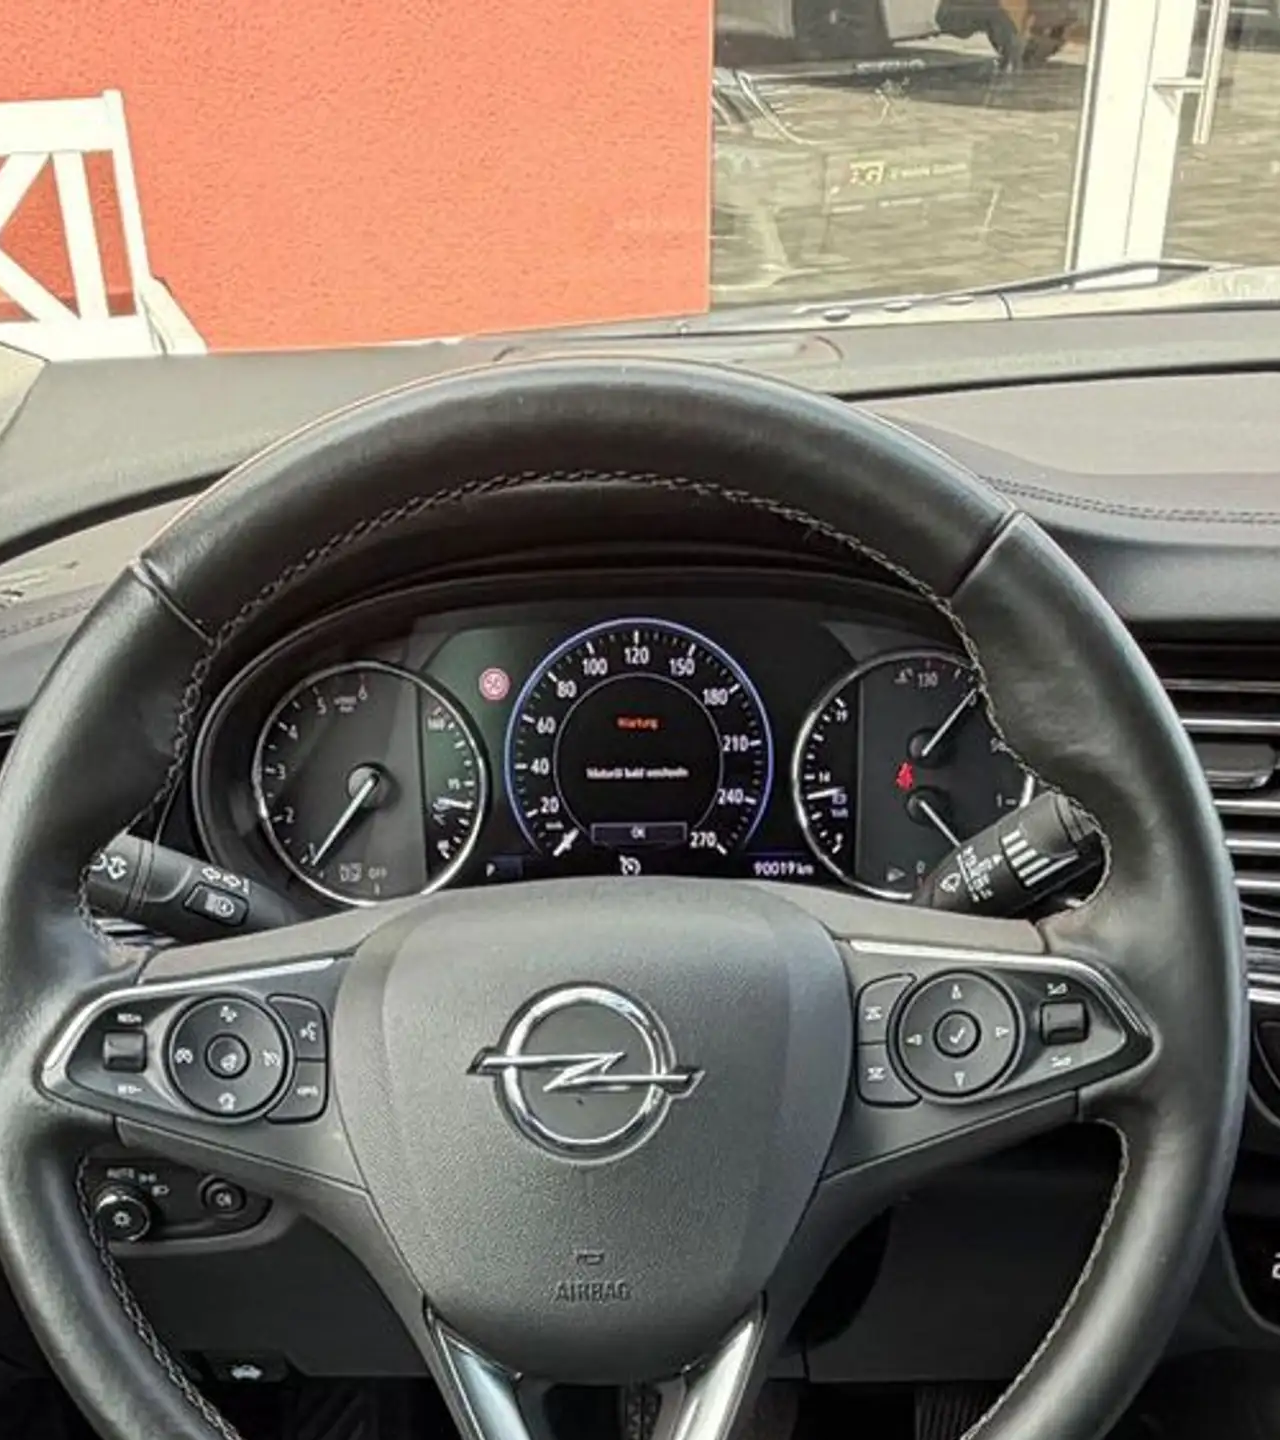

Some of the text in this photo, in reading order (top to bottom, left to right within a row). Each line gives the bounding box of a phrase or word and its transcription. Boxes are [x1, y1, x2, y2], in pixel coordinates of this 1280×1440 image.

[624, 646, 650, 664] 120
[582, 658, 608, 675] 100
[669, 657, 695, 676] 150
[556, 680, 577, 698] 80
[702, 688, 729, 706] 180
[536, 717, 556, 735] 60
[723, 734, 749, 752] 210
[276, 763, 286, 781] 3
[530, 757, 550, 775] 40
[540, 795, 561, 814] 20
[718, 787, 745, 805] 240
[286, 806, 295, 824] 2
[690, 831, 718, 848] 270
[554, 1281, 630, 1302] AIRBAG
